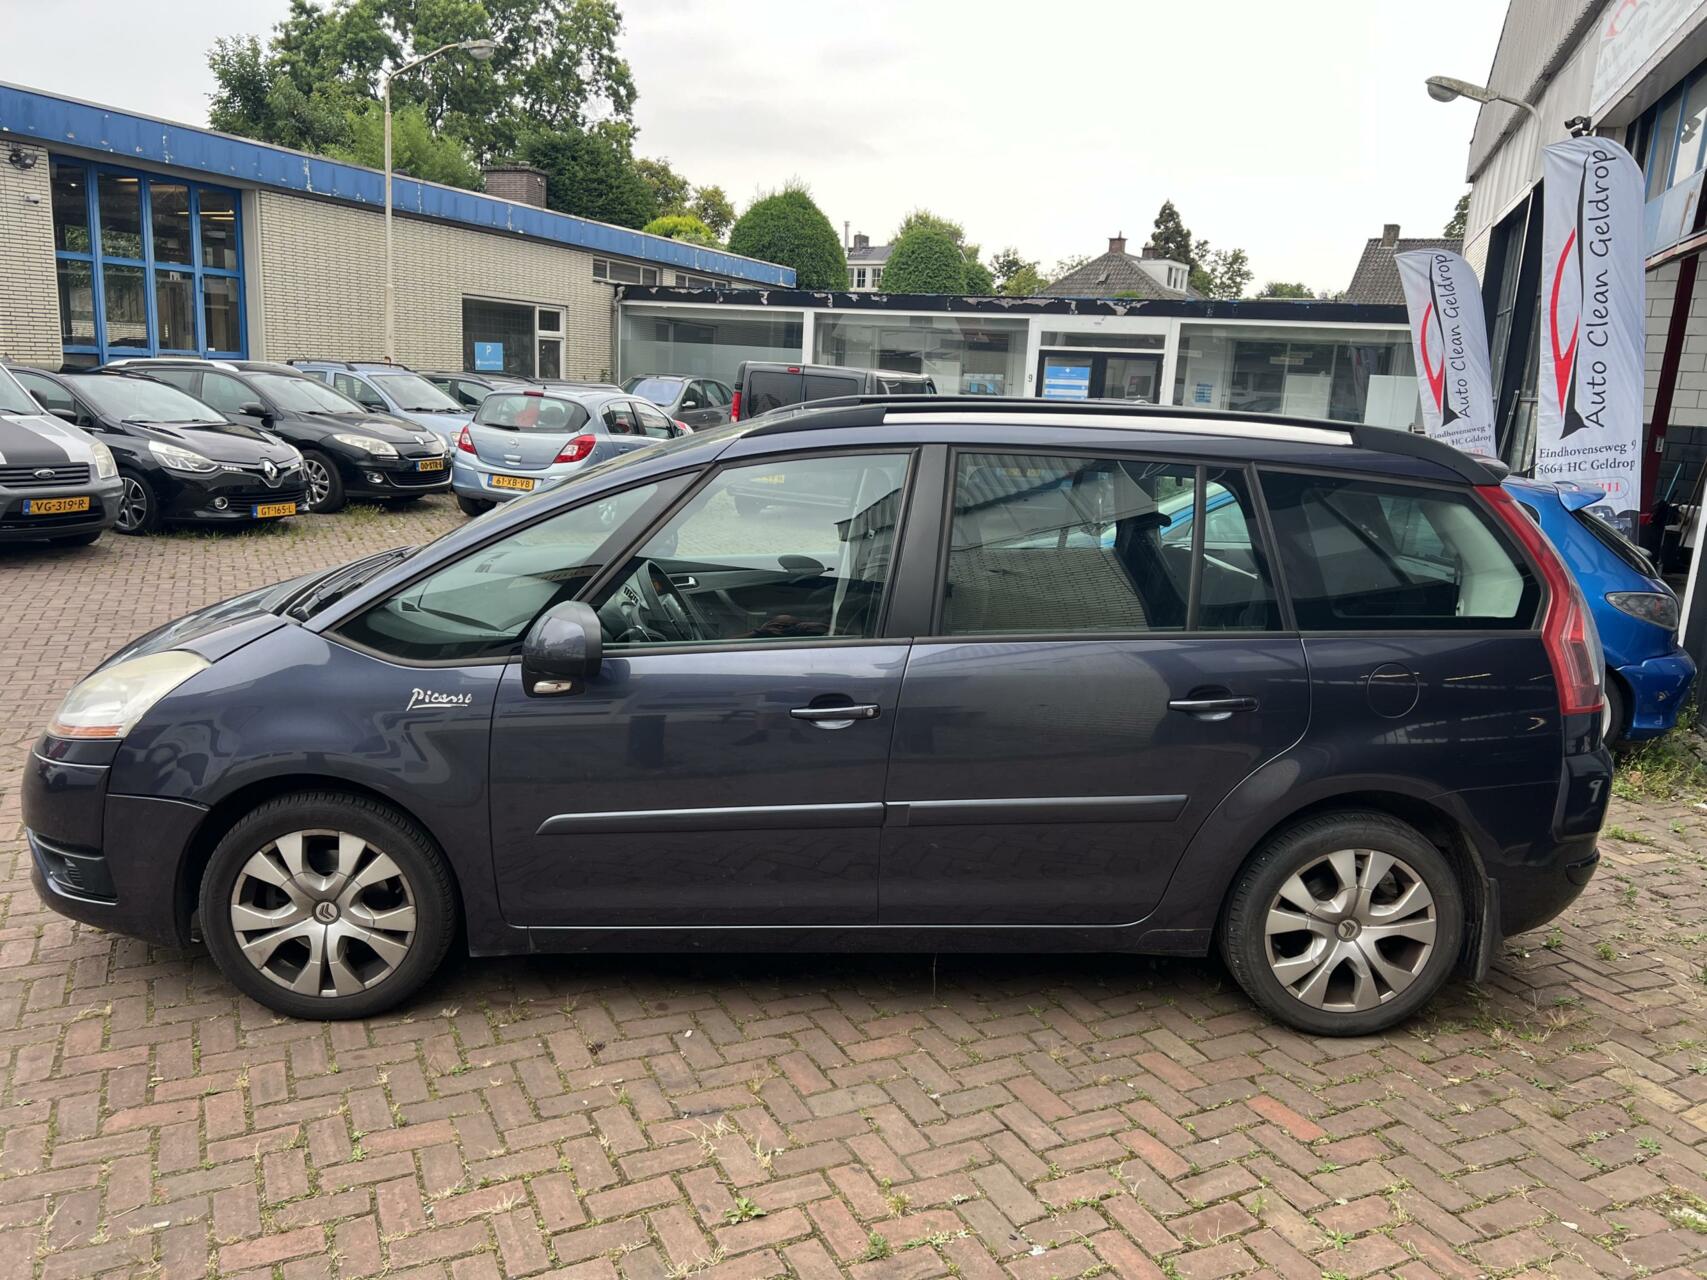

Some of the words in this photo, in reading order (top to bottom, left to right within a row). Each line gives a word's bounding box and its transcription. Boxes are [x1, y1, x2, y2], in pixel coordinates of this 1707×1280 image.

[1586, 149, 1617, 258] Geldrop
[1435, 254, 1459, 318] Geldrop
[1585, 268, 1610, 348] Clean
[1448, 324, 1467, 371] Clean
[1458, 378, 1471, 418] Auto
[1585, 360, 1608, 428] Auto
[1538, 463, 1563, 475] 5664
[1567, 461, 1587, 473] HC
[1539, 443, 1627, 459] Eindhovenseweg
[1631, 440, 1637, 452] 9
[35, 499, 86, 512] VG-319-R
[261, 504, 293, 516] GT-165-L
[406, 688, 473, 712] Picasso
